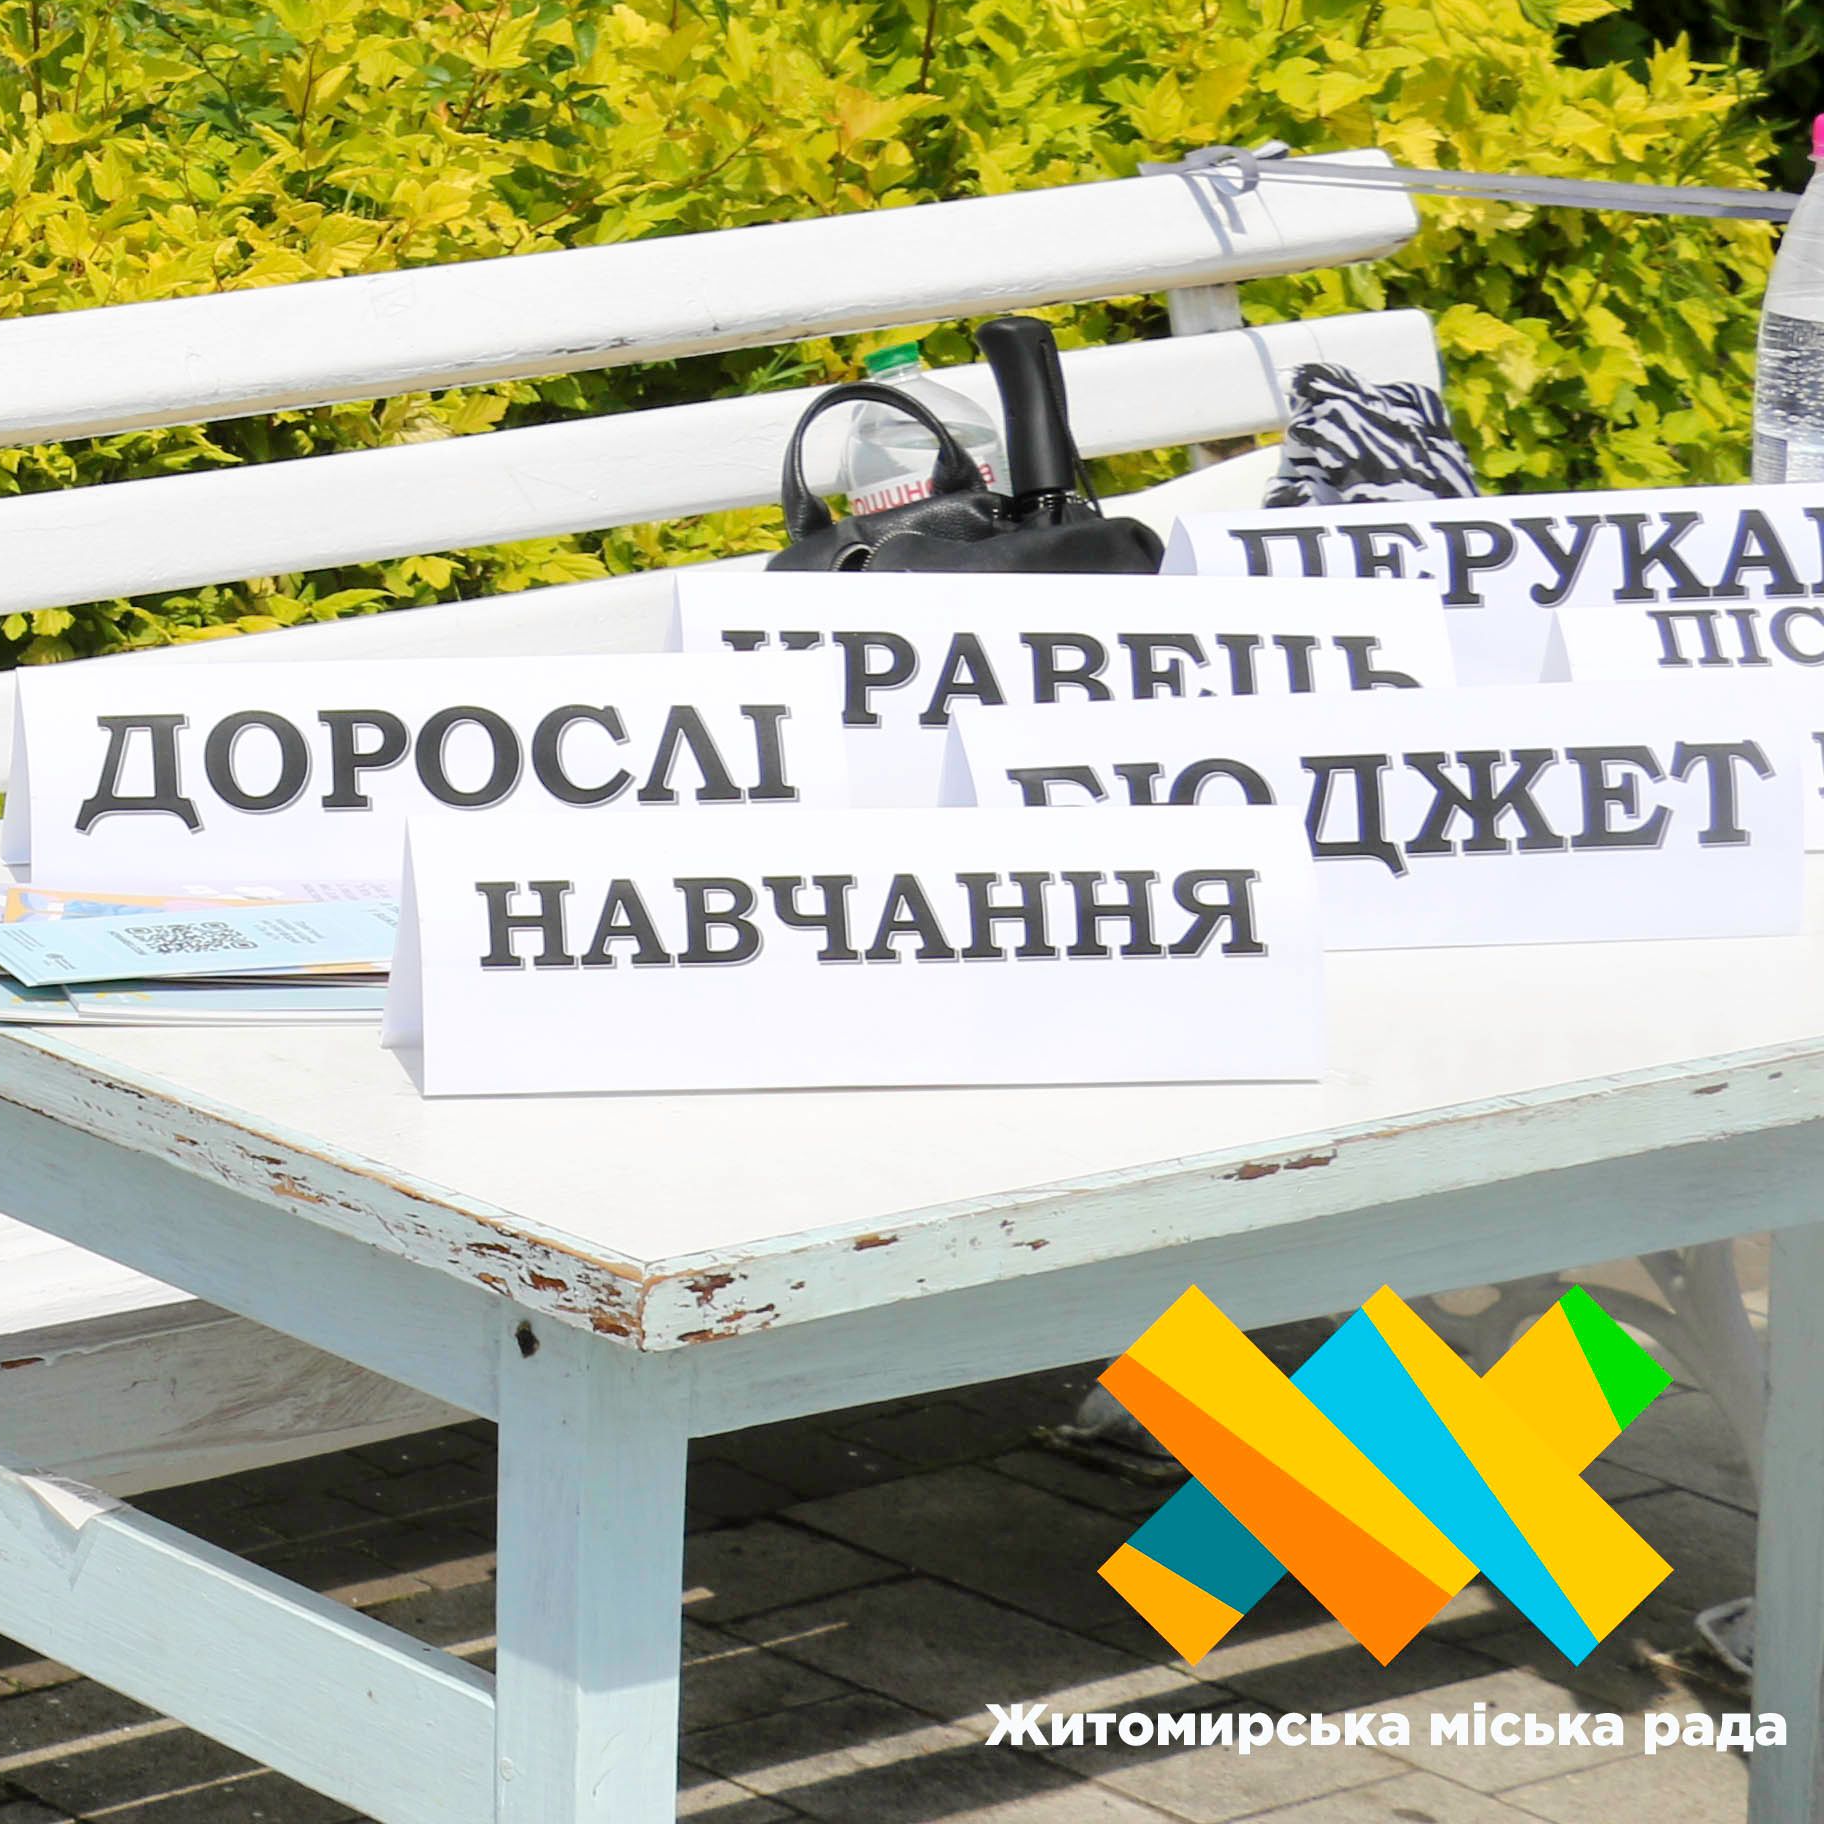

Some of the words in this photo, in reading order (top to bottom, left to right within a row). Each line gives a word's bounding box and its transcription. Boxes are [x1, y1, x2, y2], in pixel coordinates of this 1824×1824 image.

[1229, 508, 1824, 608] ПЕРУКА
[721, 630, 1424, 729] РАВЕЦЬ
[75, 702, 800, 836] ДОРОСЛІ
[476, 867, 1271, 971] НАВЧАННЯ
